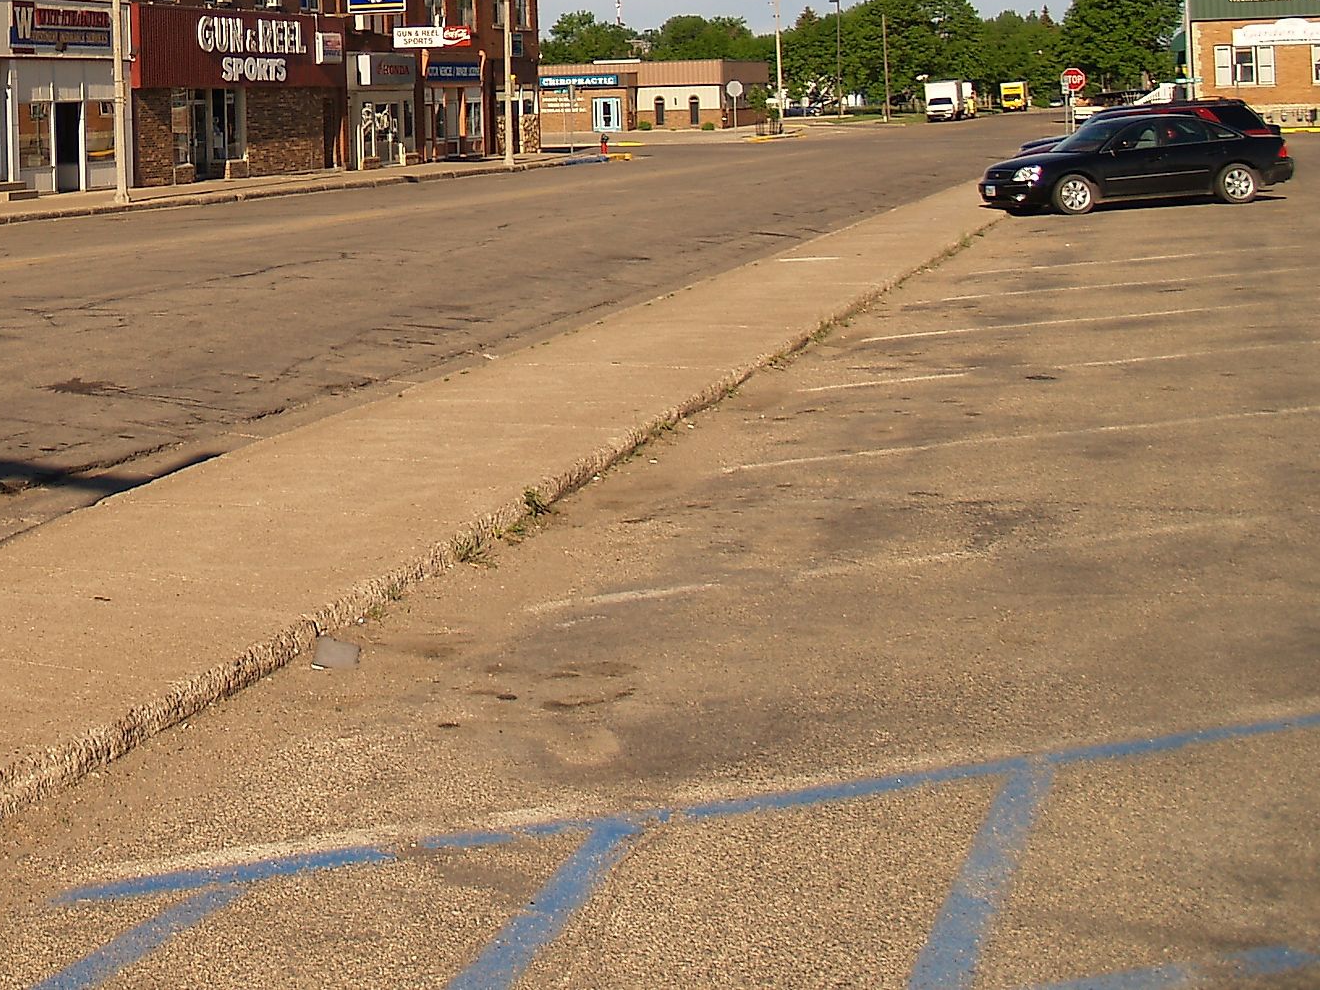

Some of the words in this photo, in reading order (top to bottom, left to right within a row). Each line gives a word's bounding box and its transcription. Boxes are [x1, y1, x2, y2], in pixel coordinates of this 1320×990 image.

[197, 15, 244, 53] GUN
[245, 28, 257, 53] &
[258, 18, 307, 54] REEL
[421, 29, 440, 37] REEL
[403, 37, 434, 45] SPORTS
[221, 56, 287, 82] SPORTS
[542, 77, 614, 86] CHIROPRACTIC
[1064, 74, 1083, 84] TOP
